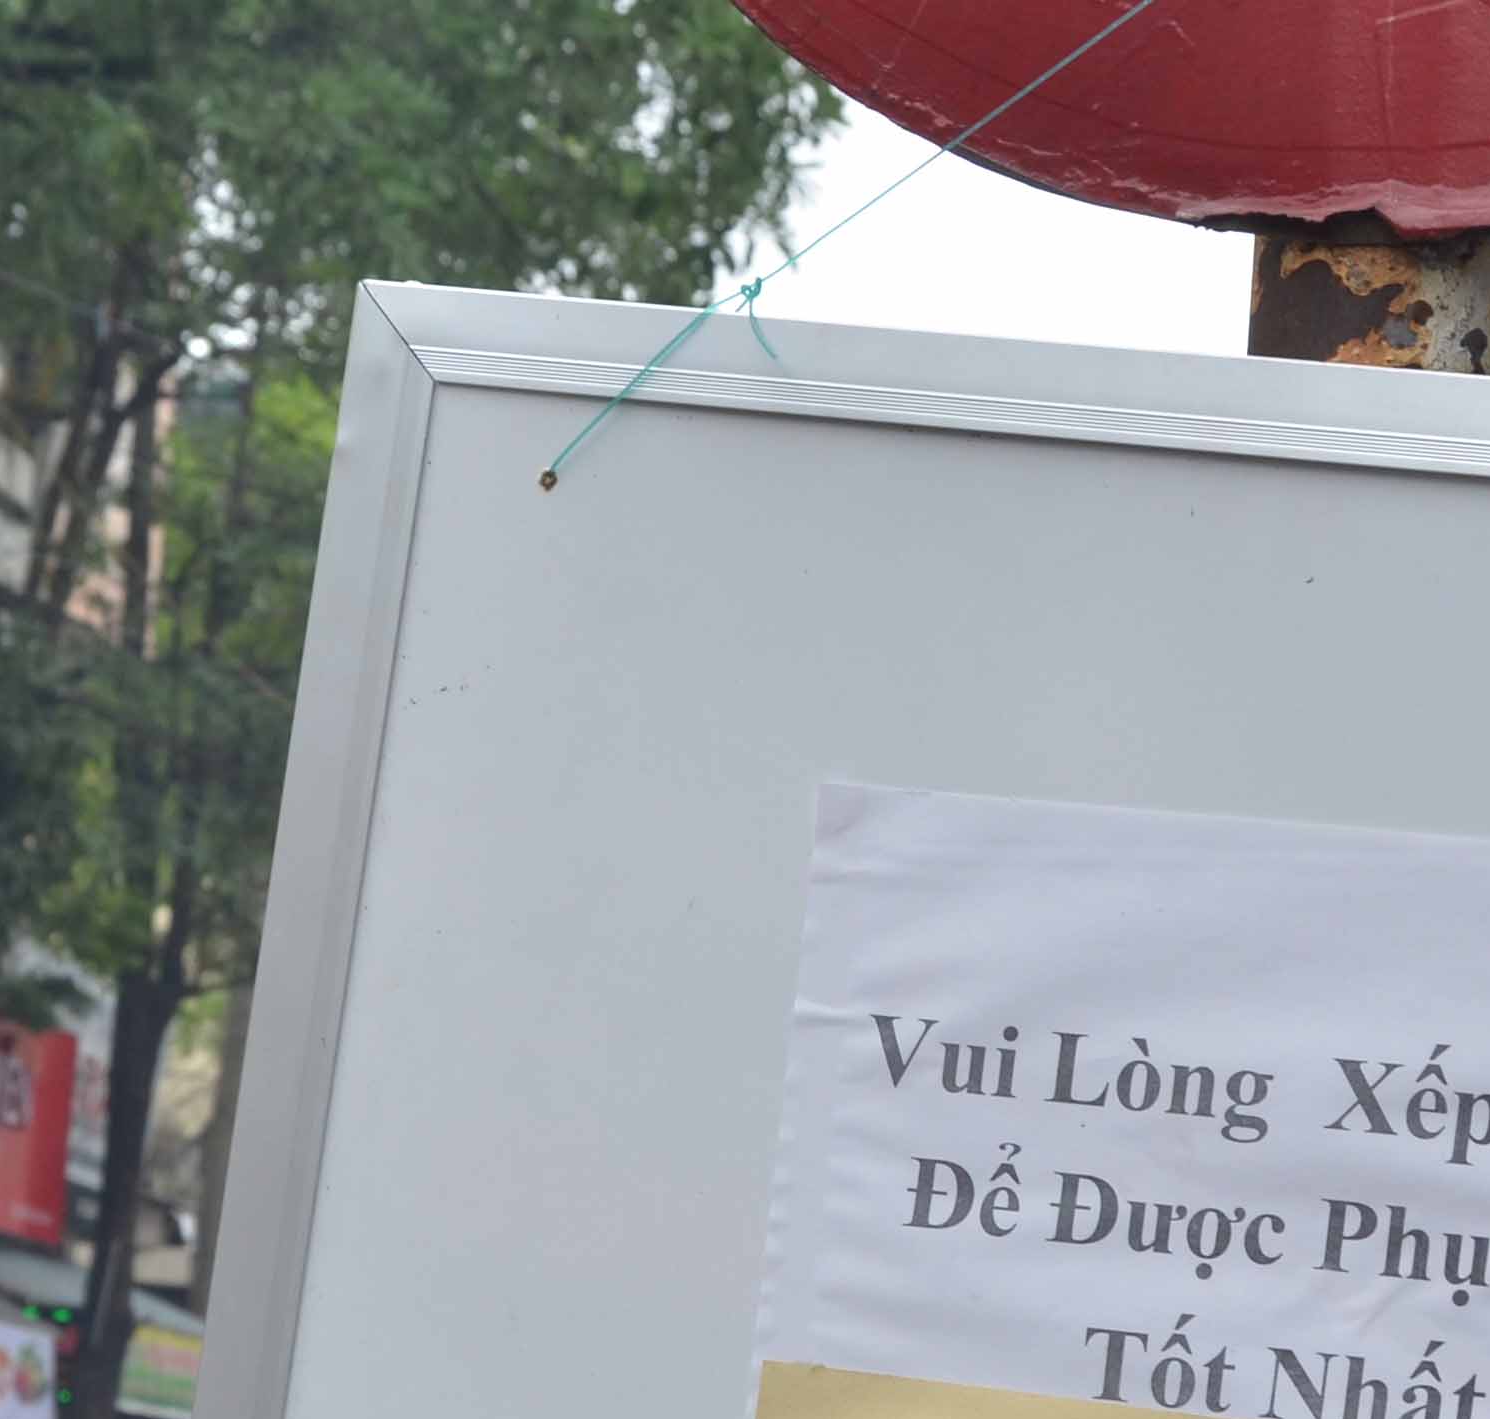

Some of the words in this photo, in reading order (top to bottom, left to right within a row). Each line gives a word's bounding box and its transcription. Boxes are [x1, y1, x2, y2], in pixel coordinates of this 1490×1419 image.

[871, 1015, 1018, 1097] Vui
[1046, 1032, 1273, 1143] Lòng
[903, 1142, 1020, 1236] Để
[1047, 1172, 1284, 1279] Được
[1086, 1314, 1235, 1412] Tốt
